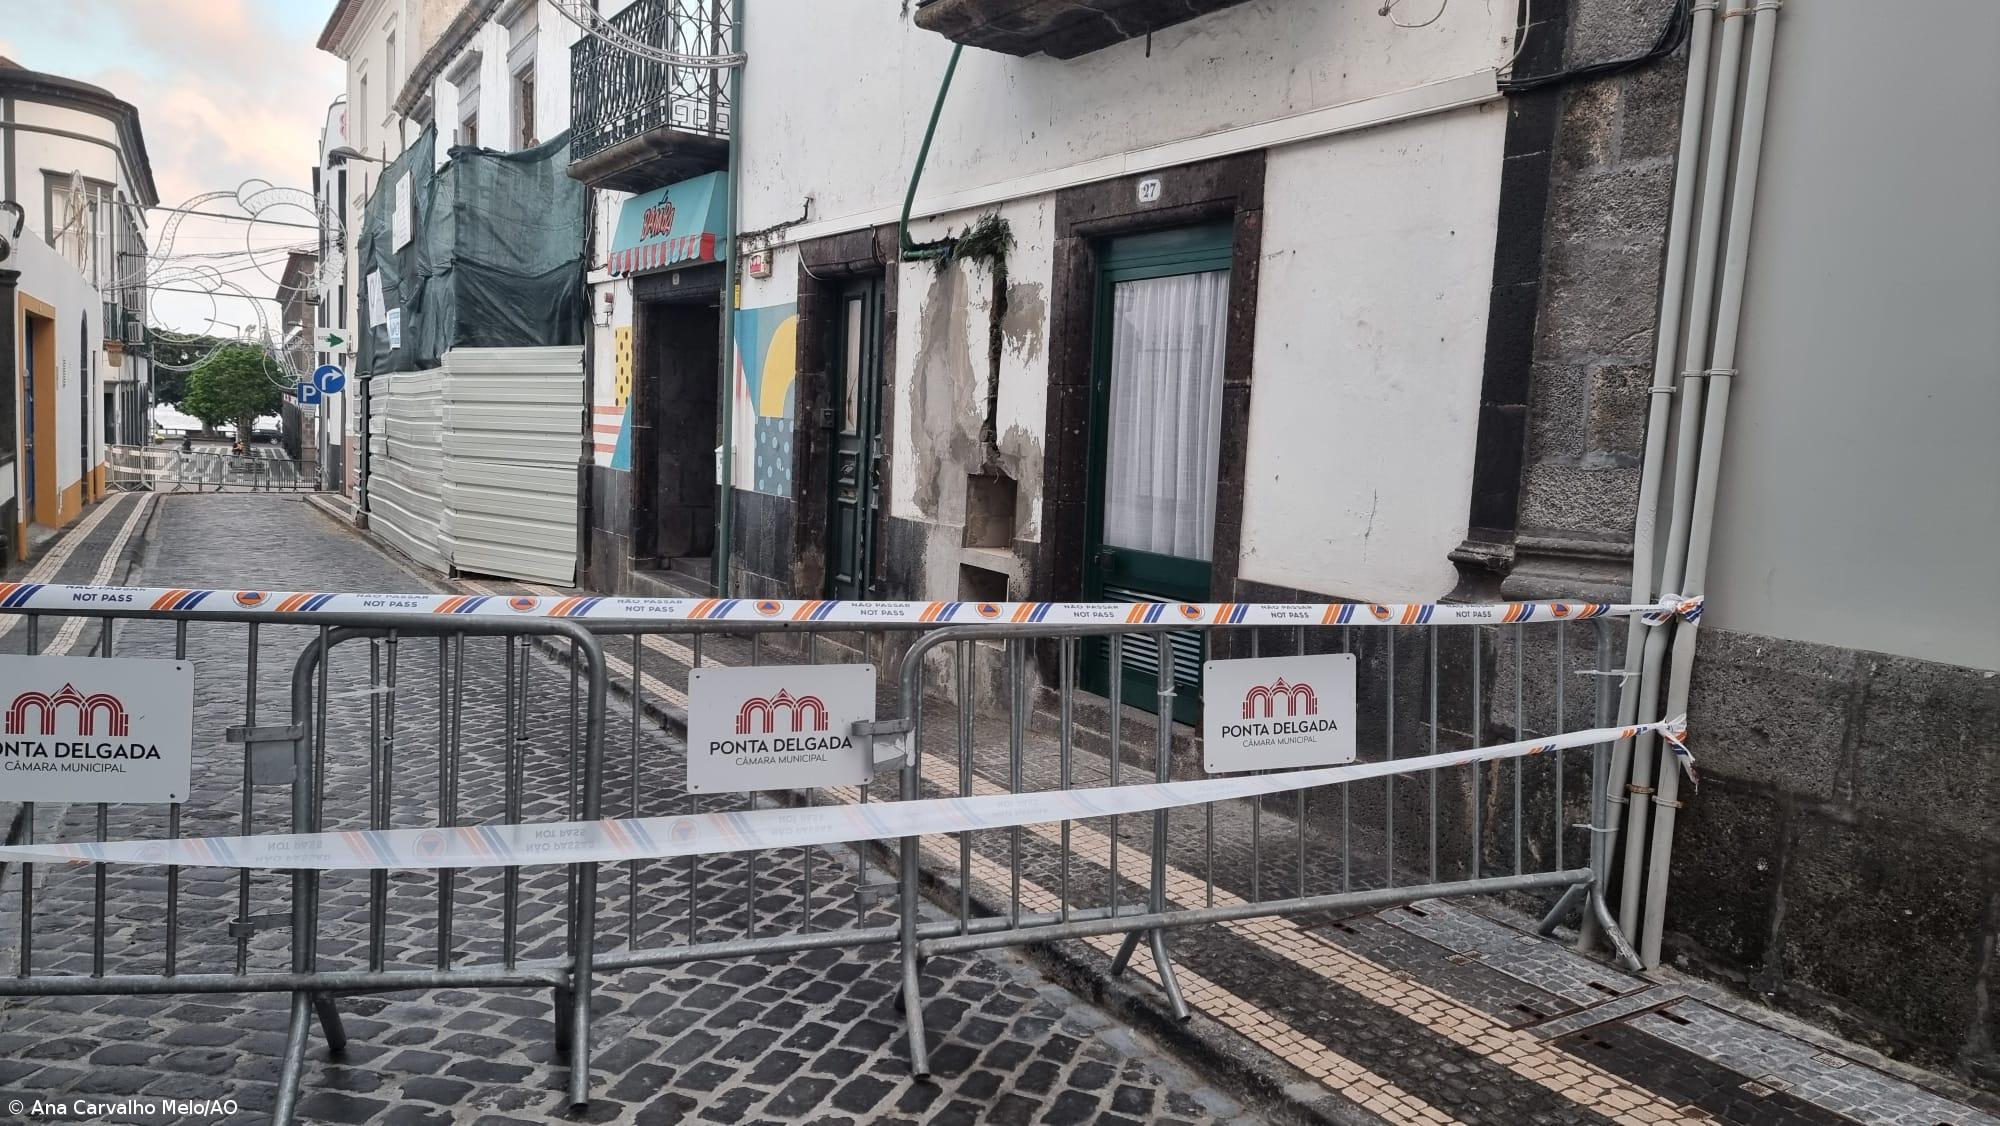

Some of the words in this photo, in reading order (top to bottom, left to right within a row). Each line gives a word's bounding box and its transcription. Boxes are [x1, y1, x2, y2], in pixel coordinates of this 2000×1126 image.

[1143, 183, 1157, 198] 27
[302, 385, 317, 402] P
[72, 593, 98, 602] NOT
[100, 594, 133, 602] PASS
[1288, 611, 1310, 619] PASS
[1222, 723, 1269, 738] PONTA
[1273, 719, 1338, 735] DELGADA
[709, 739, 769, 755] PONTA
[773, 735, 853, 752] DELGADA
[1242, 738, 1275, 748] CÂMARA
[1277, 735, 1317, 745] MUNICIPAL
[0, 741, 49, 758] NTA
[54, 742, 162, 760] DELGADA
[735, 754, 776, 766] CÂMARA
[778, 752, 828, 764] MUNICIPAL
[4, 760, 58, 773] CÂMARA
[60, 762, 128, 774] MUNICIPAL
